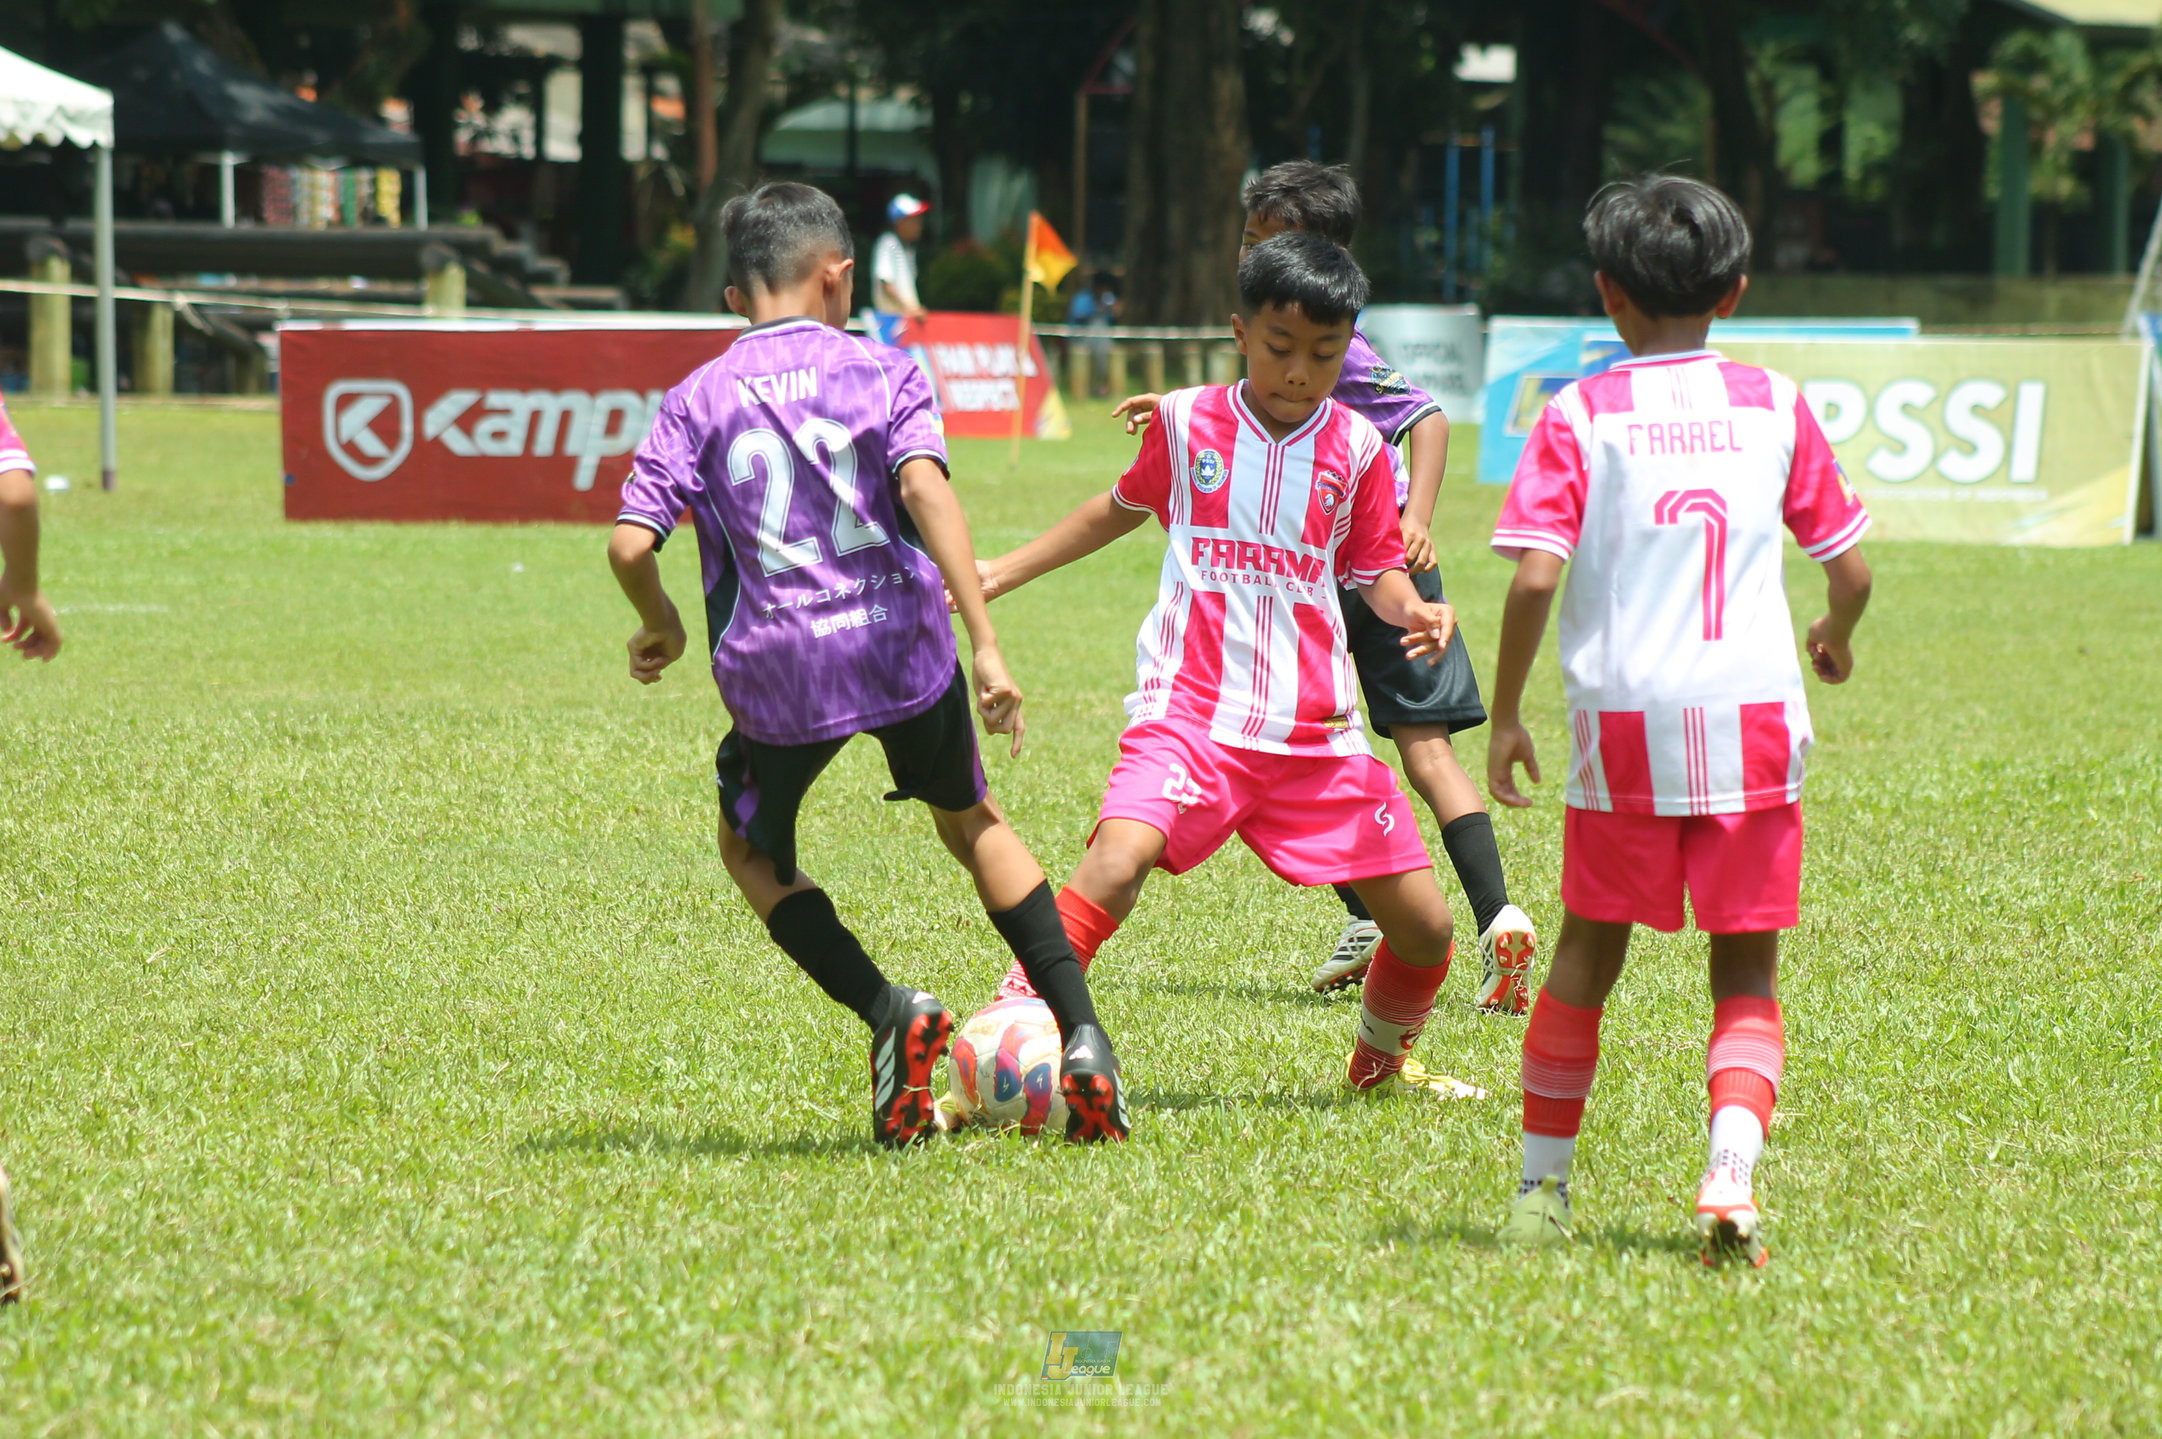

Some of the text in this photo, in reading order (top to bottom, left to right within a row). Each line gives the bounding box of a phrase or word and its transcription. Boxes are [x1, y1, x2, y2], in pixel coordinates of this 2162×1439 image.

[737, 366, 818, 408] KEVIN
[1627, 420, 1742, 455] FARREL
[1802, 377, 2047, 485] PSSI
[727, 417, 891, 578] 22
[1654, 488, 1727, 641] 7
[1285, 581, 1314, 597] CLB
[810, 604, 888, 638] 協同組合
